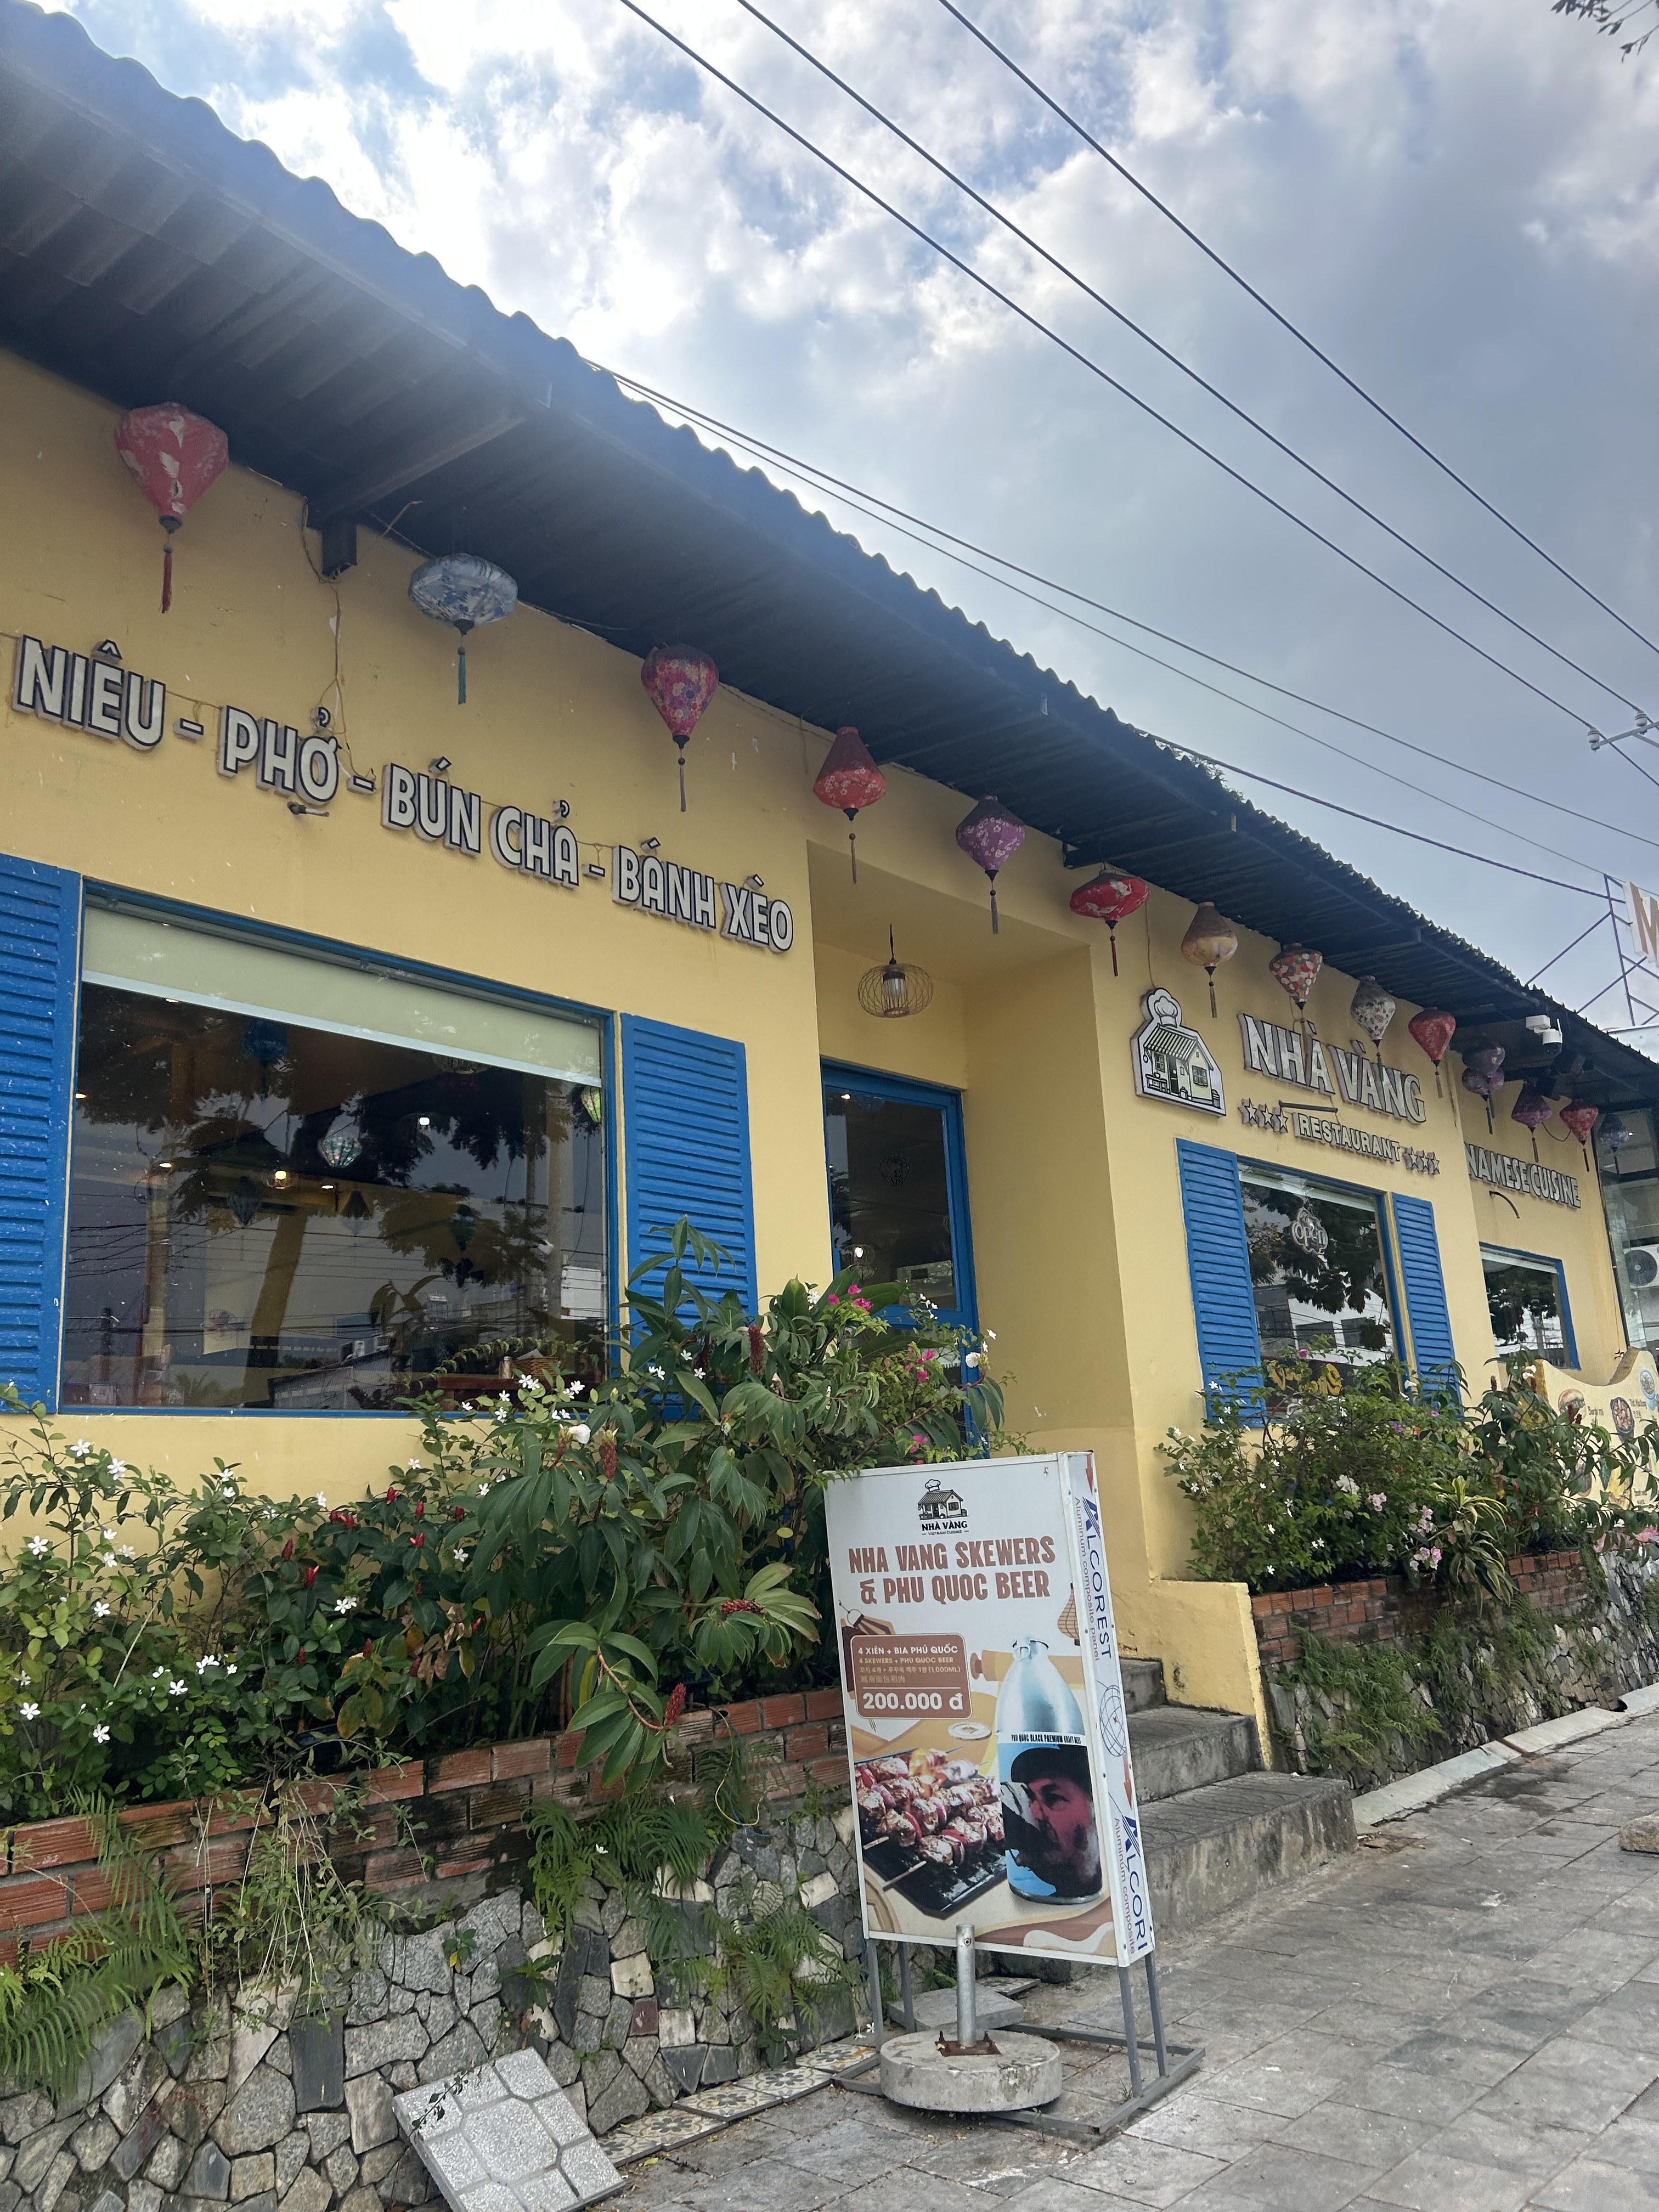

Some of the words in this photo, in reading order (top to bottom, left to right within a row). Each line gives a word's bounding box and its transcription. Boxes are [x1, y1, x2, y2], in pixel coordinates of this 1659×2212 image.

[14, 635, 166, 749] NIÊU
[221, 706, 341, 805] PHỞ
[386, 757, 482, 855] BÚN
[493, 800, 579, 888] CHẢ
[615, 837, 716, 930] BÁNH
[722, 874, 794, 953] XÈO
[1240, 1013, 1335, 1094] NHÀ
[1330, 1040, 1426, 1123] VÀNG
[1295, 1112, 1400, 1163] RESTAURANT
[1530, 1164, 1581, 1209] CUISINE
[922, 1521, 940, 1531] NHÀ
[942, 1520, 968, 1529] VÀNG
[848, 1547, 889, 1573] NHA
[895, 1543, 949, 1571] VANG
[955, 1536, 1056, 1569] SKEWERS
[1082, 1496, 1112, 1659] ALCOREST
[860, 1578, 877, 1604] &
[883, 1576, 924, 1603] PHU
[932, 1573, 988, 1605] QUOC
[995, 1570, 1051, 1599] BEER
[1075, 1497, 1086, 1557] Aluminum
[1082, 1560, 1094, 1624] composite
[1090, 1627, 1100, 1661] panel
[911, 1644, 928, 1654] PHÚ
[930, 1643, 958, 1654] QUỐC
[862, 1692, 943, 1710] 200.000
[949, 1692, 963, 1710] đ
[1114, 1817, 1127, 1883] Aluminum
